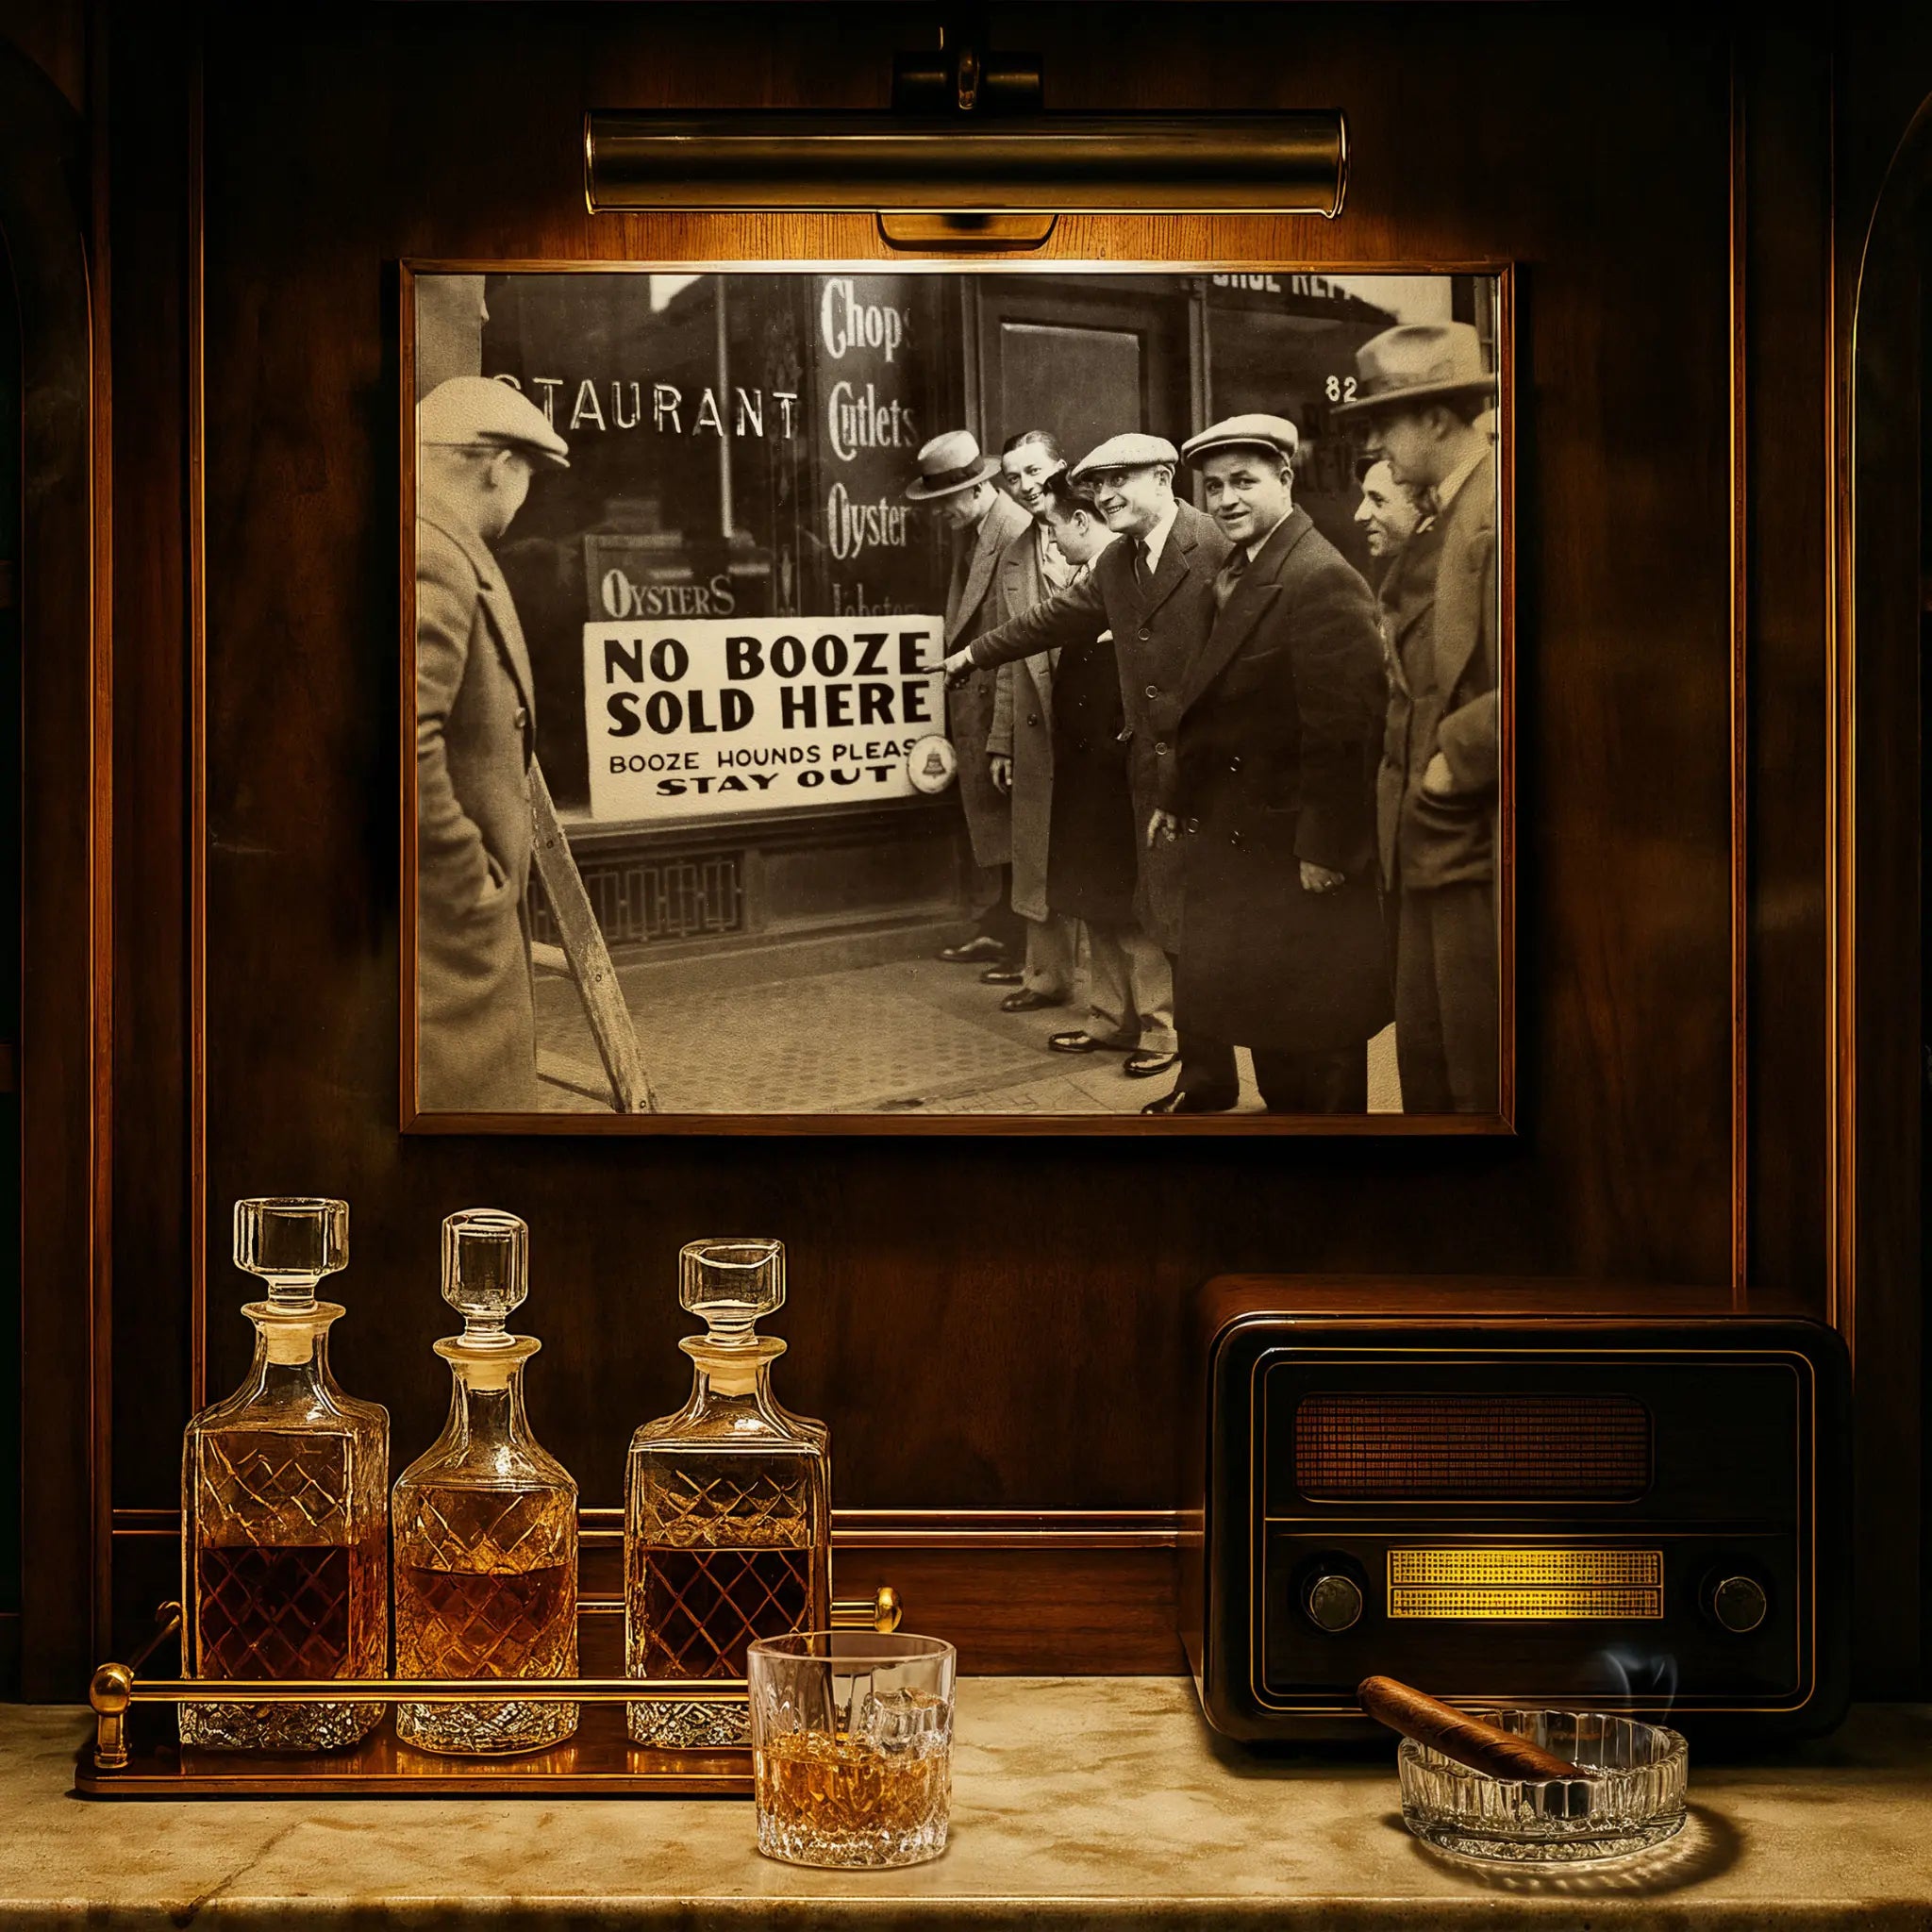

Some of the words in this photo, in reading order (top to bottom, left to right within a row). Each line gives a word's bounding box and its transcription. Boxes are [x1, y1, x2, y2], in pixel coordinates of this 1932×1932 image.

[1325, 375, 1357, 403] 82
[827, 380, 918, 461] Cutlets
[601, 568, 736, 619] OYSTERS
[604, 638, 690, 684] NO
[724, 631, 931, 681] BOOZE
[607, 687, 755, 738] SOLD
[779, 680, 932, 729] HERE
[609, 751, 701, 774] BOOZE
[717, 744, 822, 769] HOUNDS
[656, 772, 779, 796] STAY
[796, 764, 897, 789] OUT
